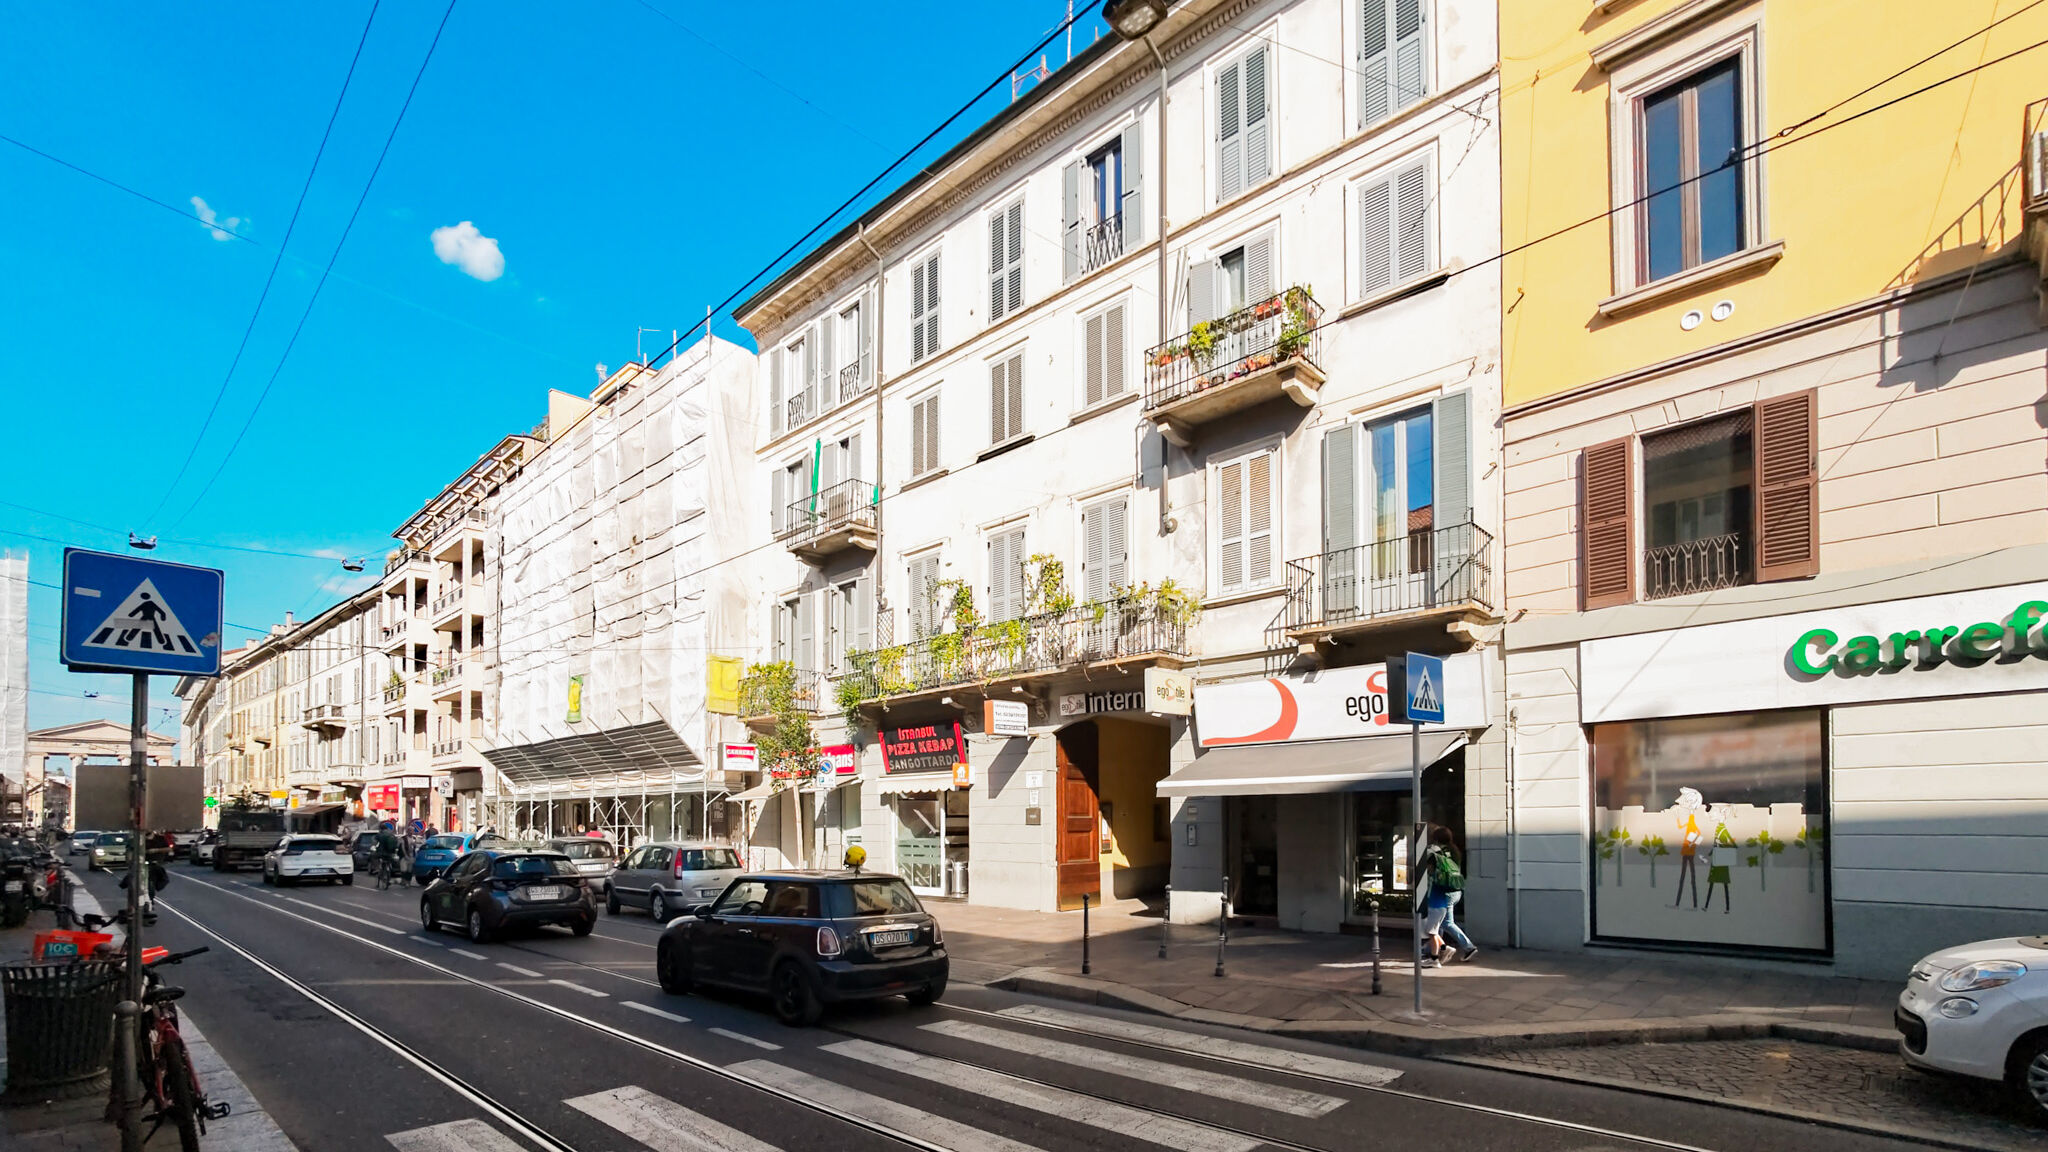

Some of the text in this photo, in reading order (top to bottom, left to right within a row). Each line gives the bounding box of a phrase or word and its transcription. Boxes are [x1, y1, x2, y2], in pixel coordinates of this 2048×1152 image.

[1791, 600, 2048, 676] Carref
[886, 738, 955, 756] PIZZA KEBAP
[889, 753, 960, 770] SANGOTTARDO
[48, 943, 73, 953] 10€
